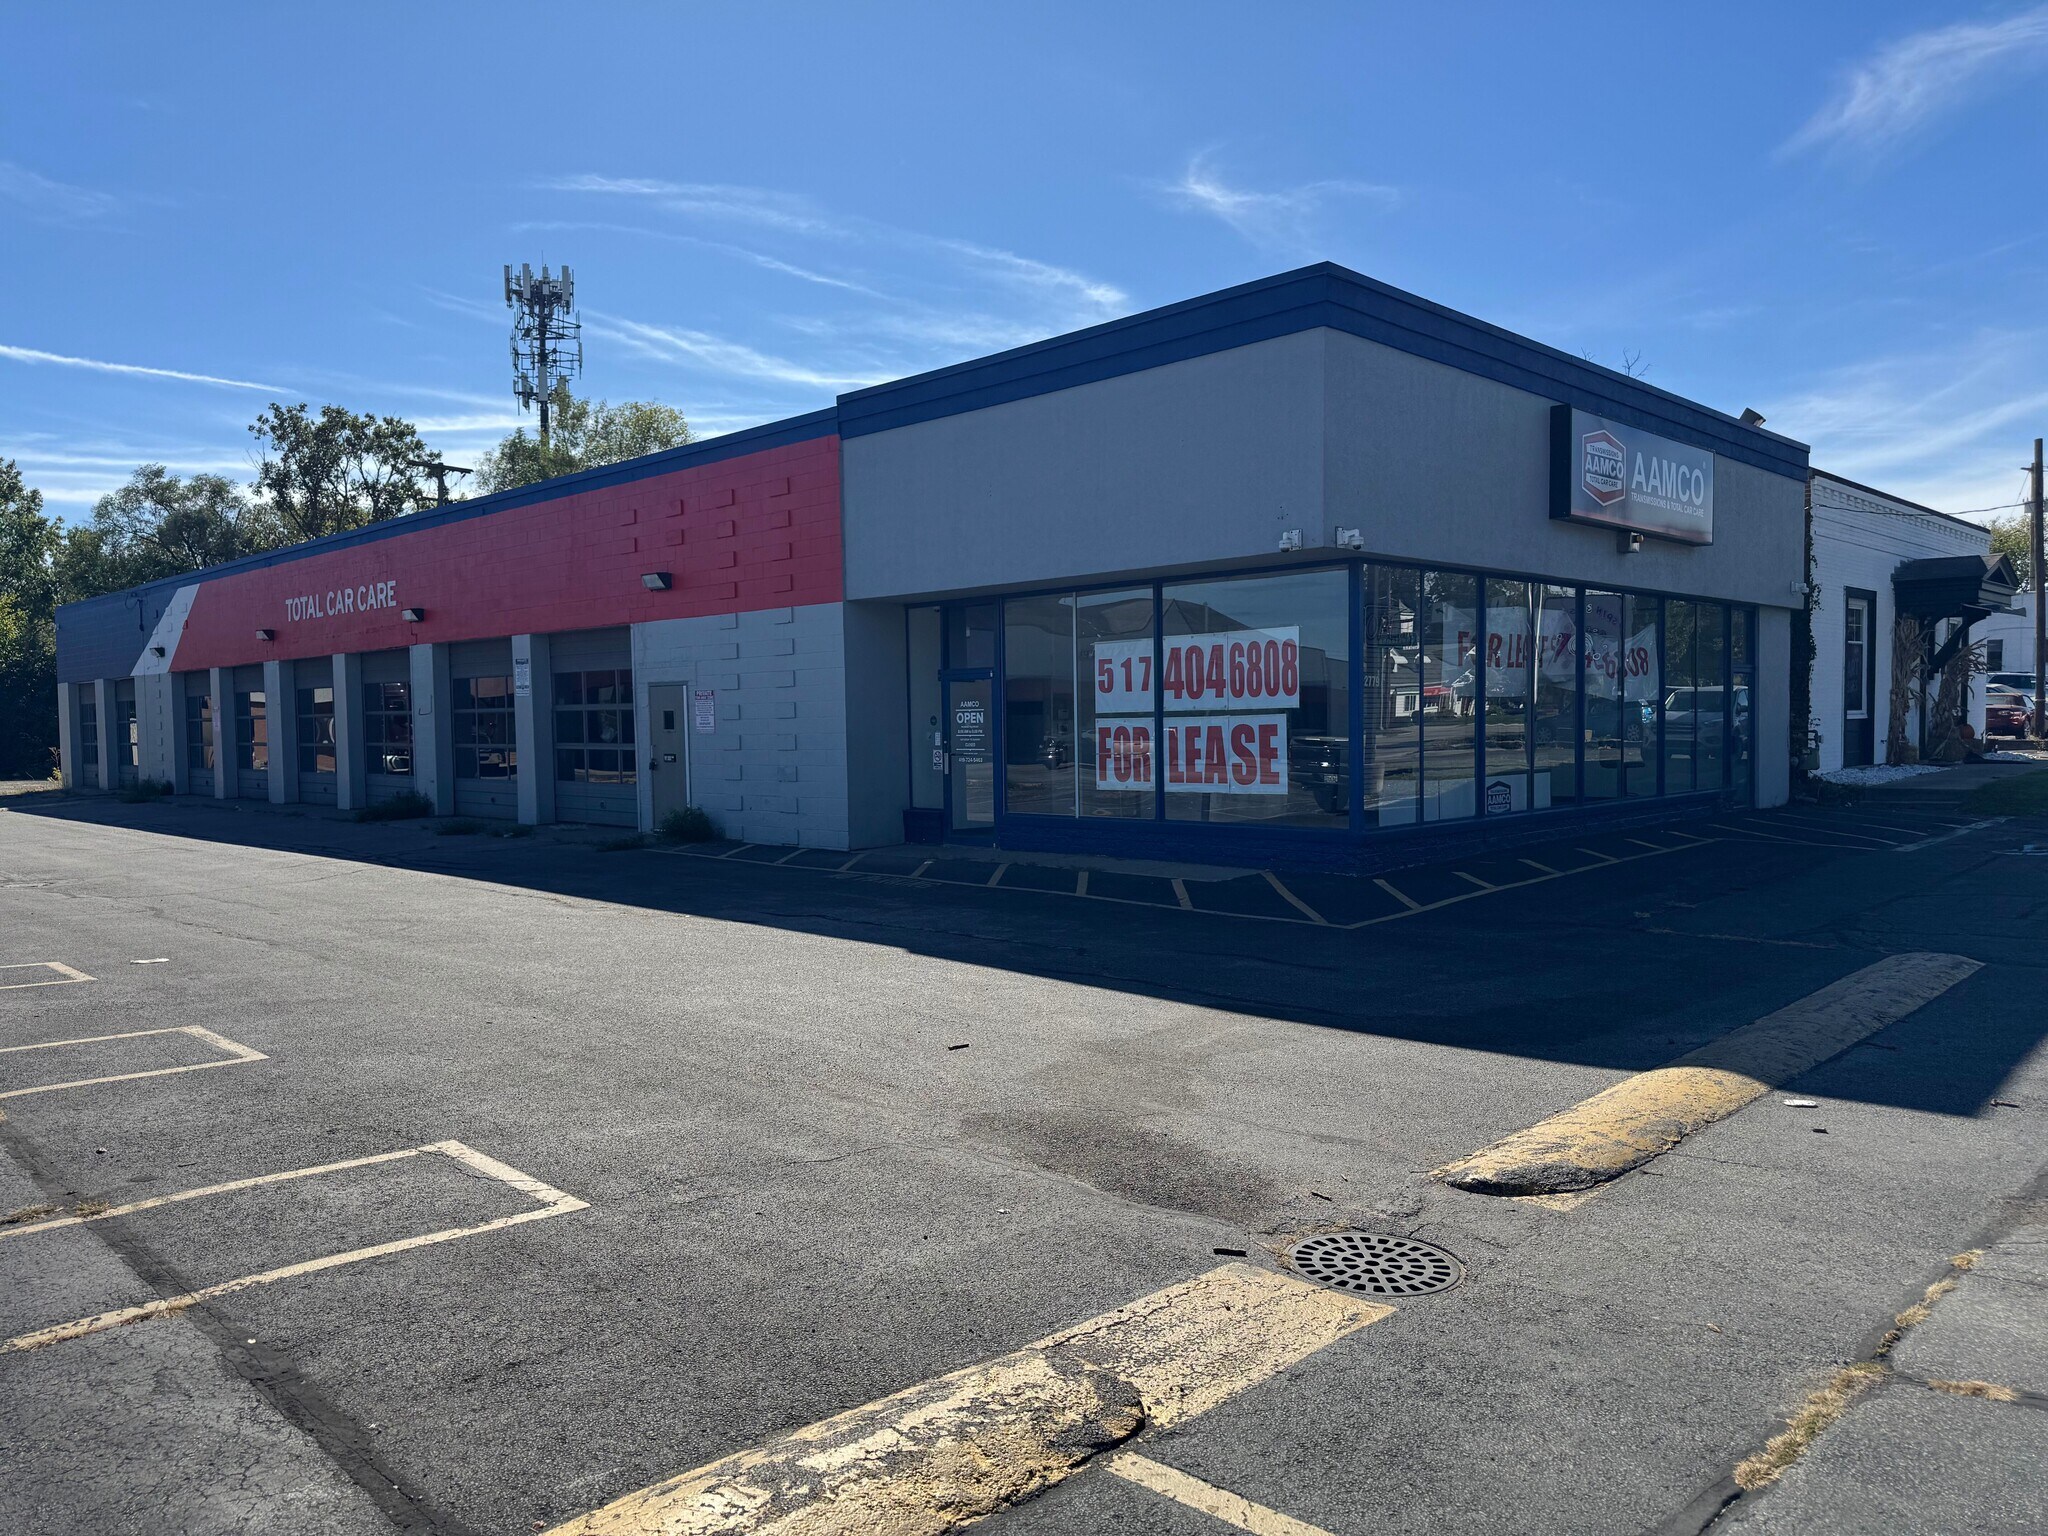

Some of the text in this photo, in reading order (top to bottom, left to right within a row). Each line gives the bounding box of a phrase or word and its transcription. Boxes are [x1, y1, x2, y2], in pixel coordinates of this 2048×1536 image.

[1589, 444, 1619, 460] TRANSMISSIONS
[1585, 454, 1624, 478] AAMCO
[1631, 451, 1704, 506] AAMCO
[1589, 475, 1600, 485] TOTAL
[1600, 478, 1609, 486] CAR
[1631, 492, 1666, 509] TRANSMISSIONS
[1670, 502, 1684, 513] TOTAL
[1684, 505, 1693, 515] CAR
[1693, 507, 1704, 518] CARE
[285, 580, 397, 622] TOTAL CAR CARE
[1457, 631, 1502, 668] FR
[1098, 656, 1152, 694] 517
[956, 712, 983, 723] OPEN
[1098, 723, 1280, 786] FOR LEASE
[1487, 794, 1511, 805] AAMCO
